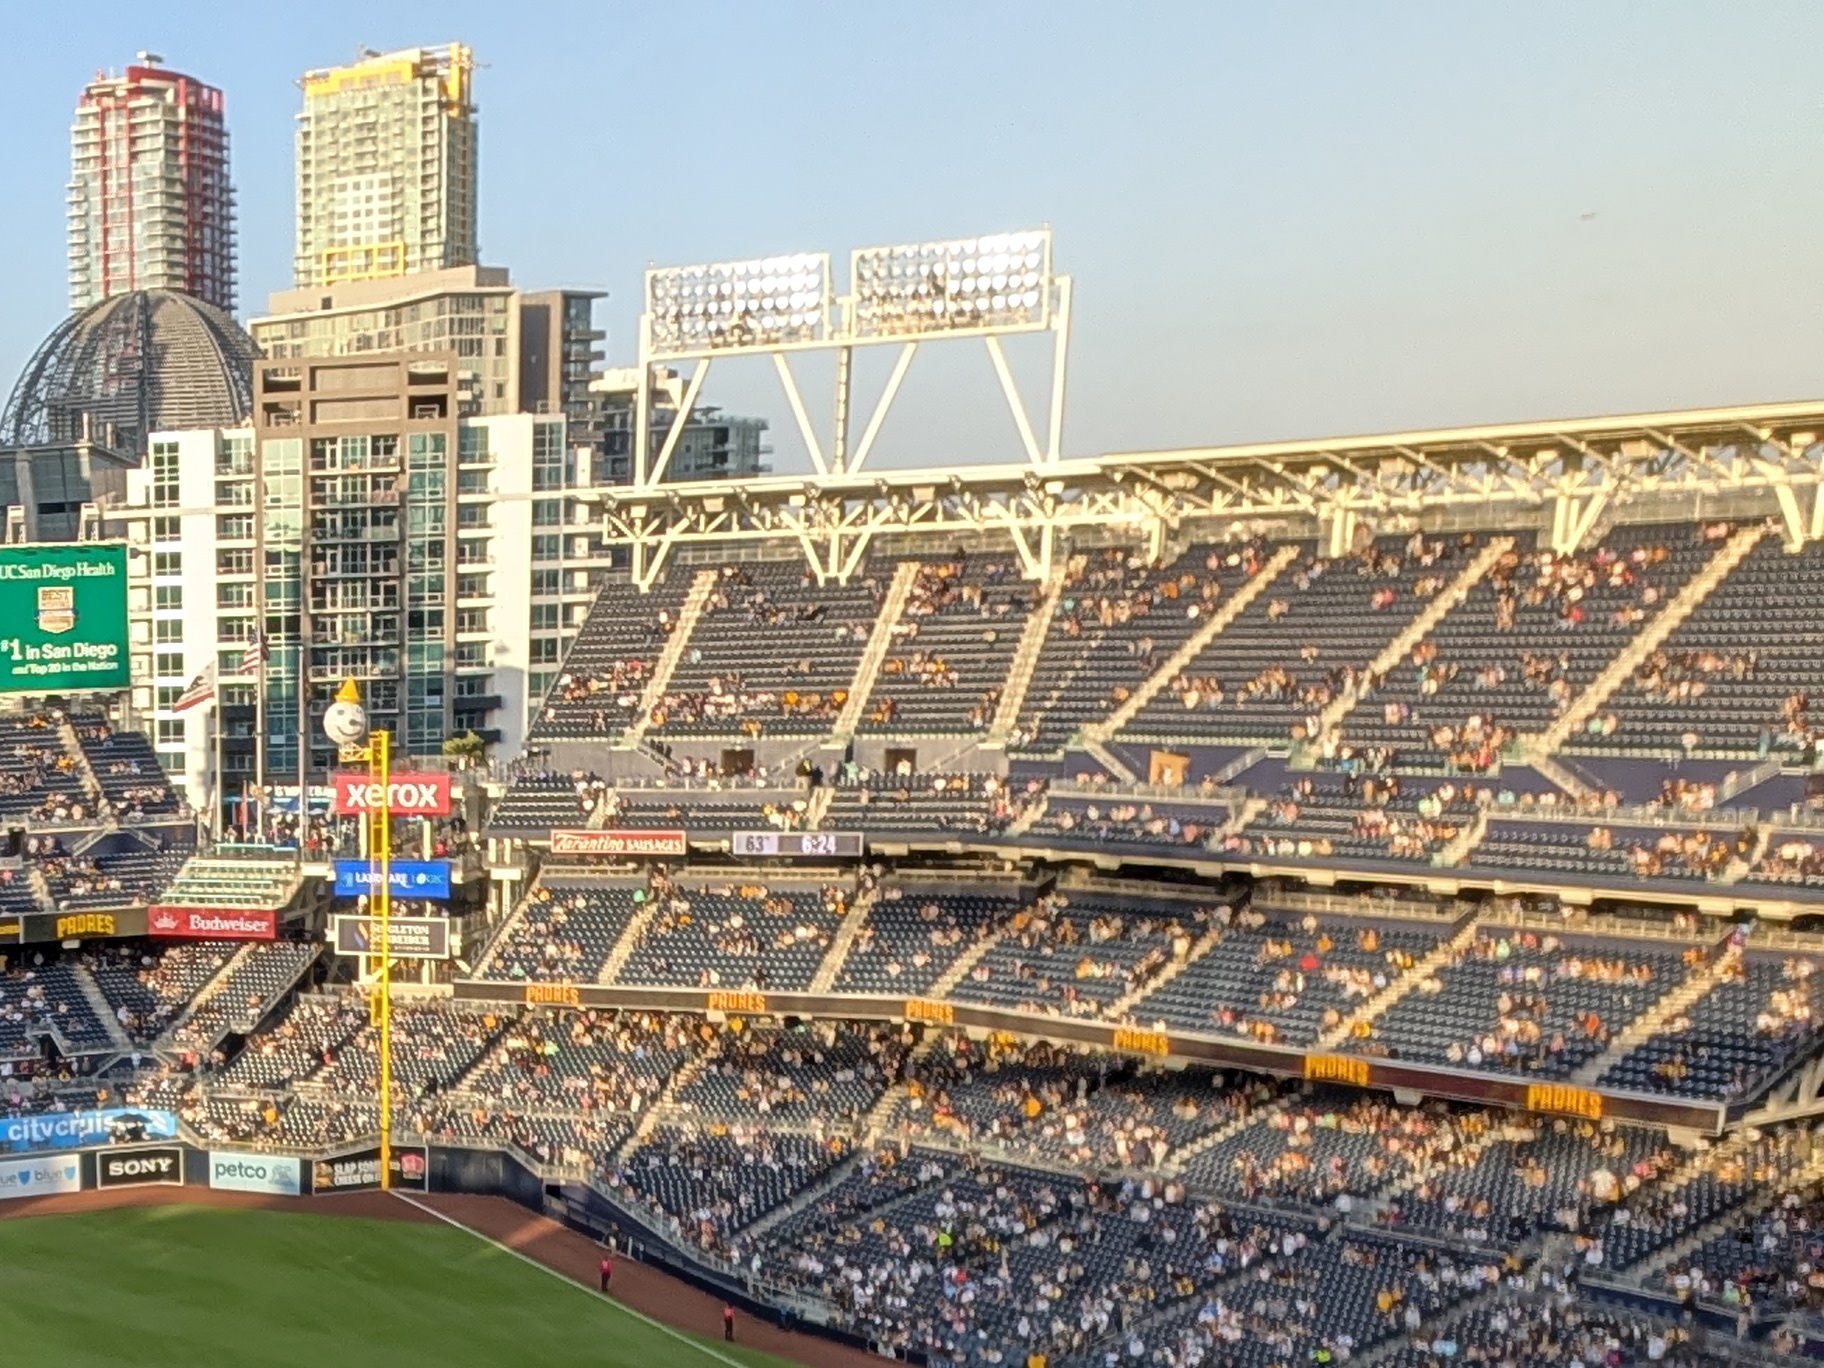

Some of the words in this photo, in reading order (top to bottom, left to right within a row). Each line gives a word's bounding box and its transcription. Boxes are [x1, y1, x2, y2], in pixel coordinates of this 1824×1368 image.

[18, 565, 41, 578] San
[42, 563, 76, 580] Diego
[77, 562, 115, 577] Health
[0, 638, 22, 660] #1
[25, 645, 40, 660] in
[42, 643, 71, 659] San
[73, 642, 117, 660] Diego
[345, 783, 438, 808] xerox
[556, 833, 624, 851] Tarantino
[57, 914, 115, 939] PADRES
[189, 914, 269, 932] Budweiser
[109, 1158, 173, 1176] SONY
[216, 1161, 267, 1180] petco
